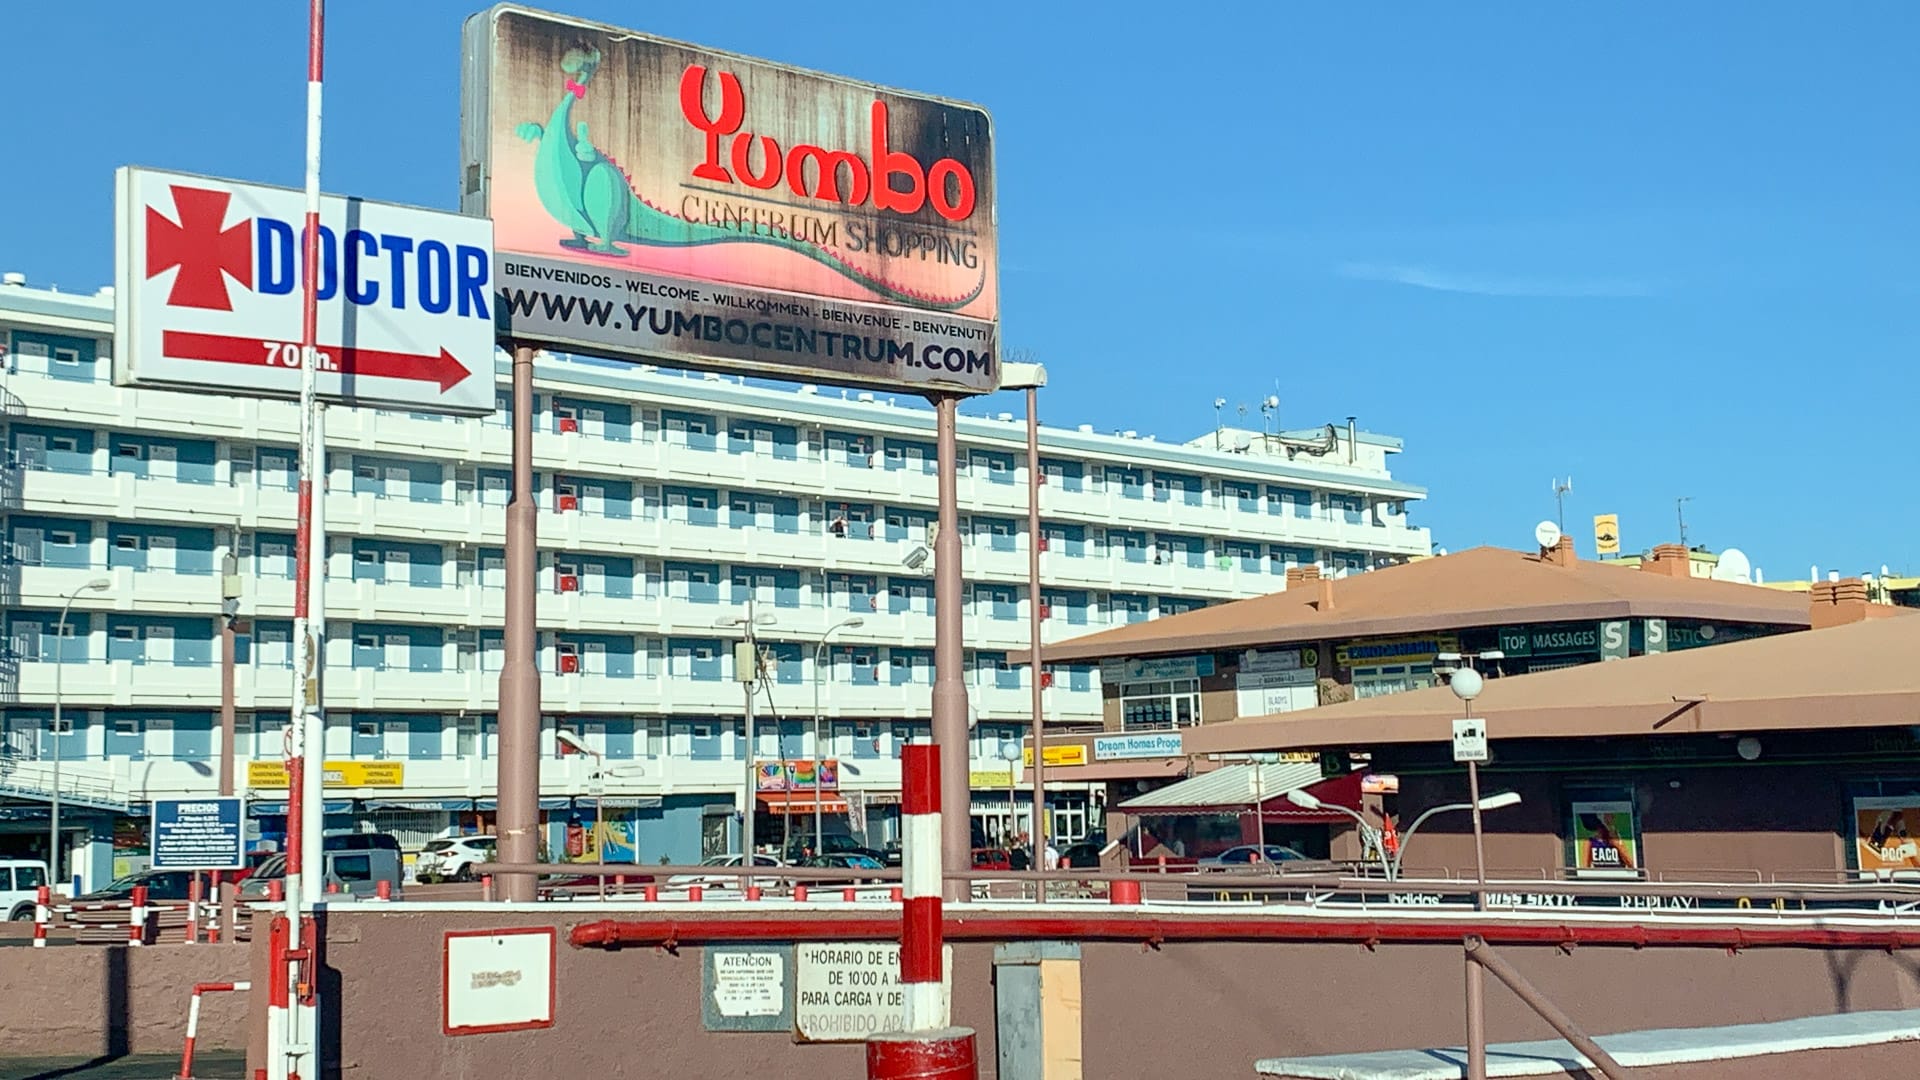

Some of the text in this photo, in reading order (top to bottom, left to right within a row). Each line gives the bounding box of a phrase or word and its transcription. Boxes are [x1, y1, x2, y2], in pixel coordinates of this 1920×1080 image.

[679, 63, 976, 222] Yumbo
[681, 194, 978, 270] CENTRUM SHOPPING
[257, 217, 491, 321] DOCTOR
[505, 262, 611, 289] BIENVENIDOS
[625, 279, 700, 302] WELCOME
[712, 292, 809, 317] WILLKOMMEN
[822, 308, 901, 329] BIENVENUE
[913, 320, 986, 340] BENVENUTI
[502, 287, 990, 376] WWW.YUMBOCENTRUM.COM
[1503, 630, 1596, 650] TOP MASSAGES
[1097, 740, 1126, 751] Dream
[1127, 738, 1156, 750] Homes
[178, 803, 219, 814] PRECIOS
[723, 956, 772, 967] ATENCION
[810, 951, 863, 965] HORARIO
[868, 951, 883, 965] DE
[828, 971, 843, 985] DE
[882, 972, 889, 985] A
[801, 991, 830, 1006] PARA
[834, 991, 872, 1006] CARGA
[876, 992, 883, 1006] Y
[801, 1013, 877, 1033] PROHIBIDO
